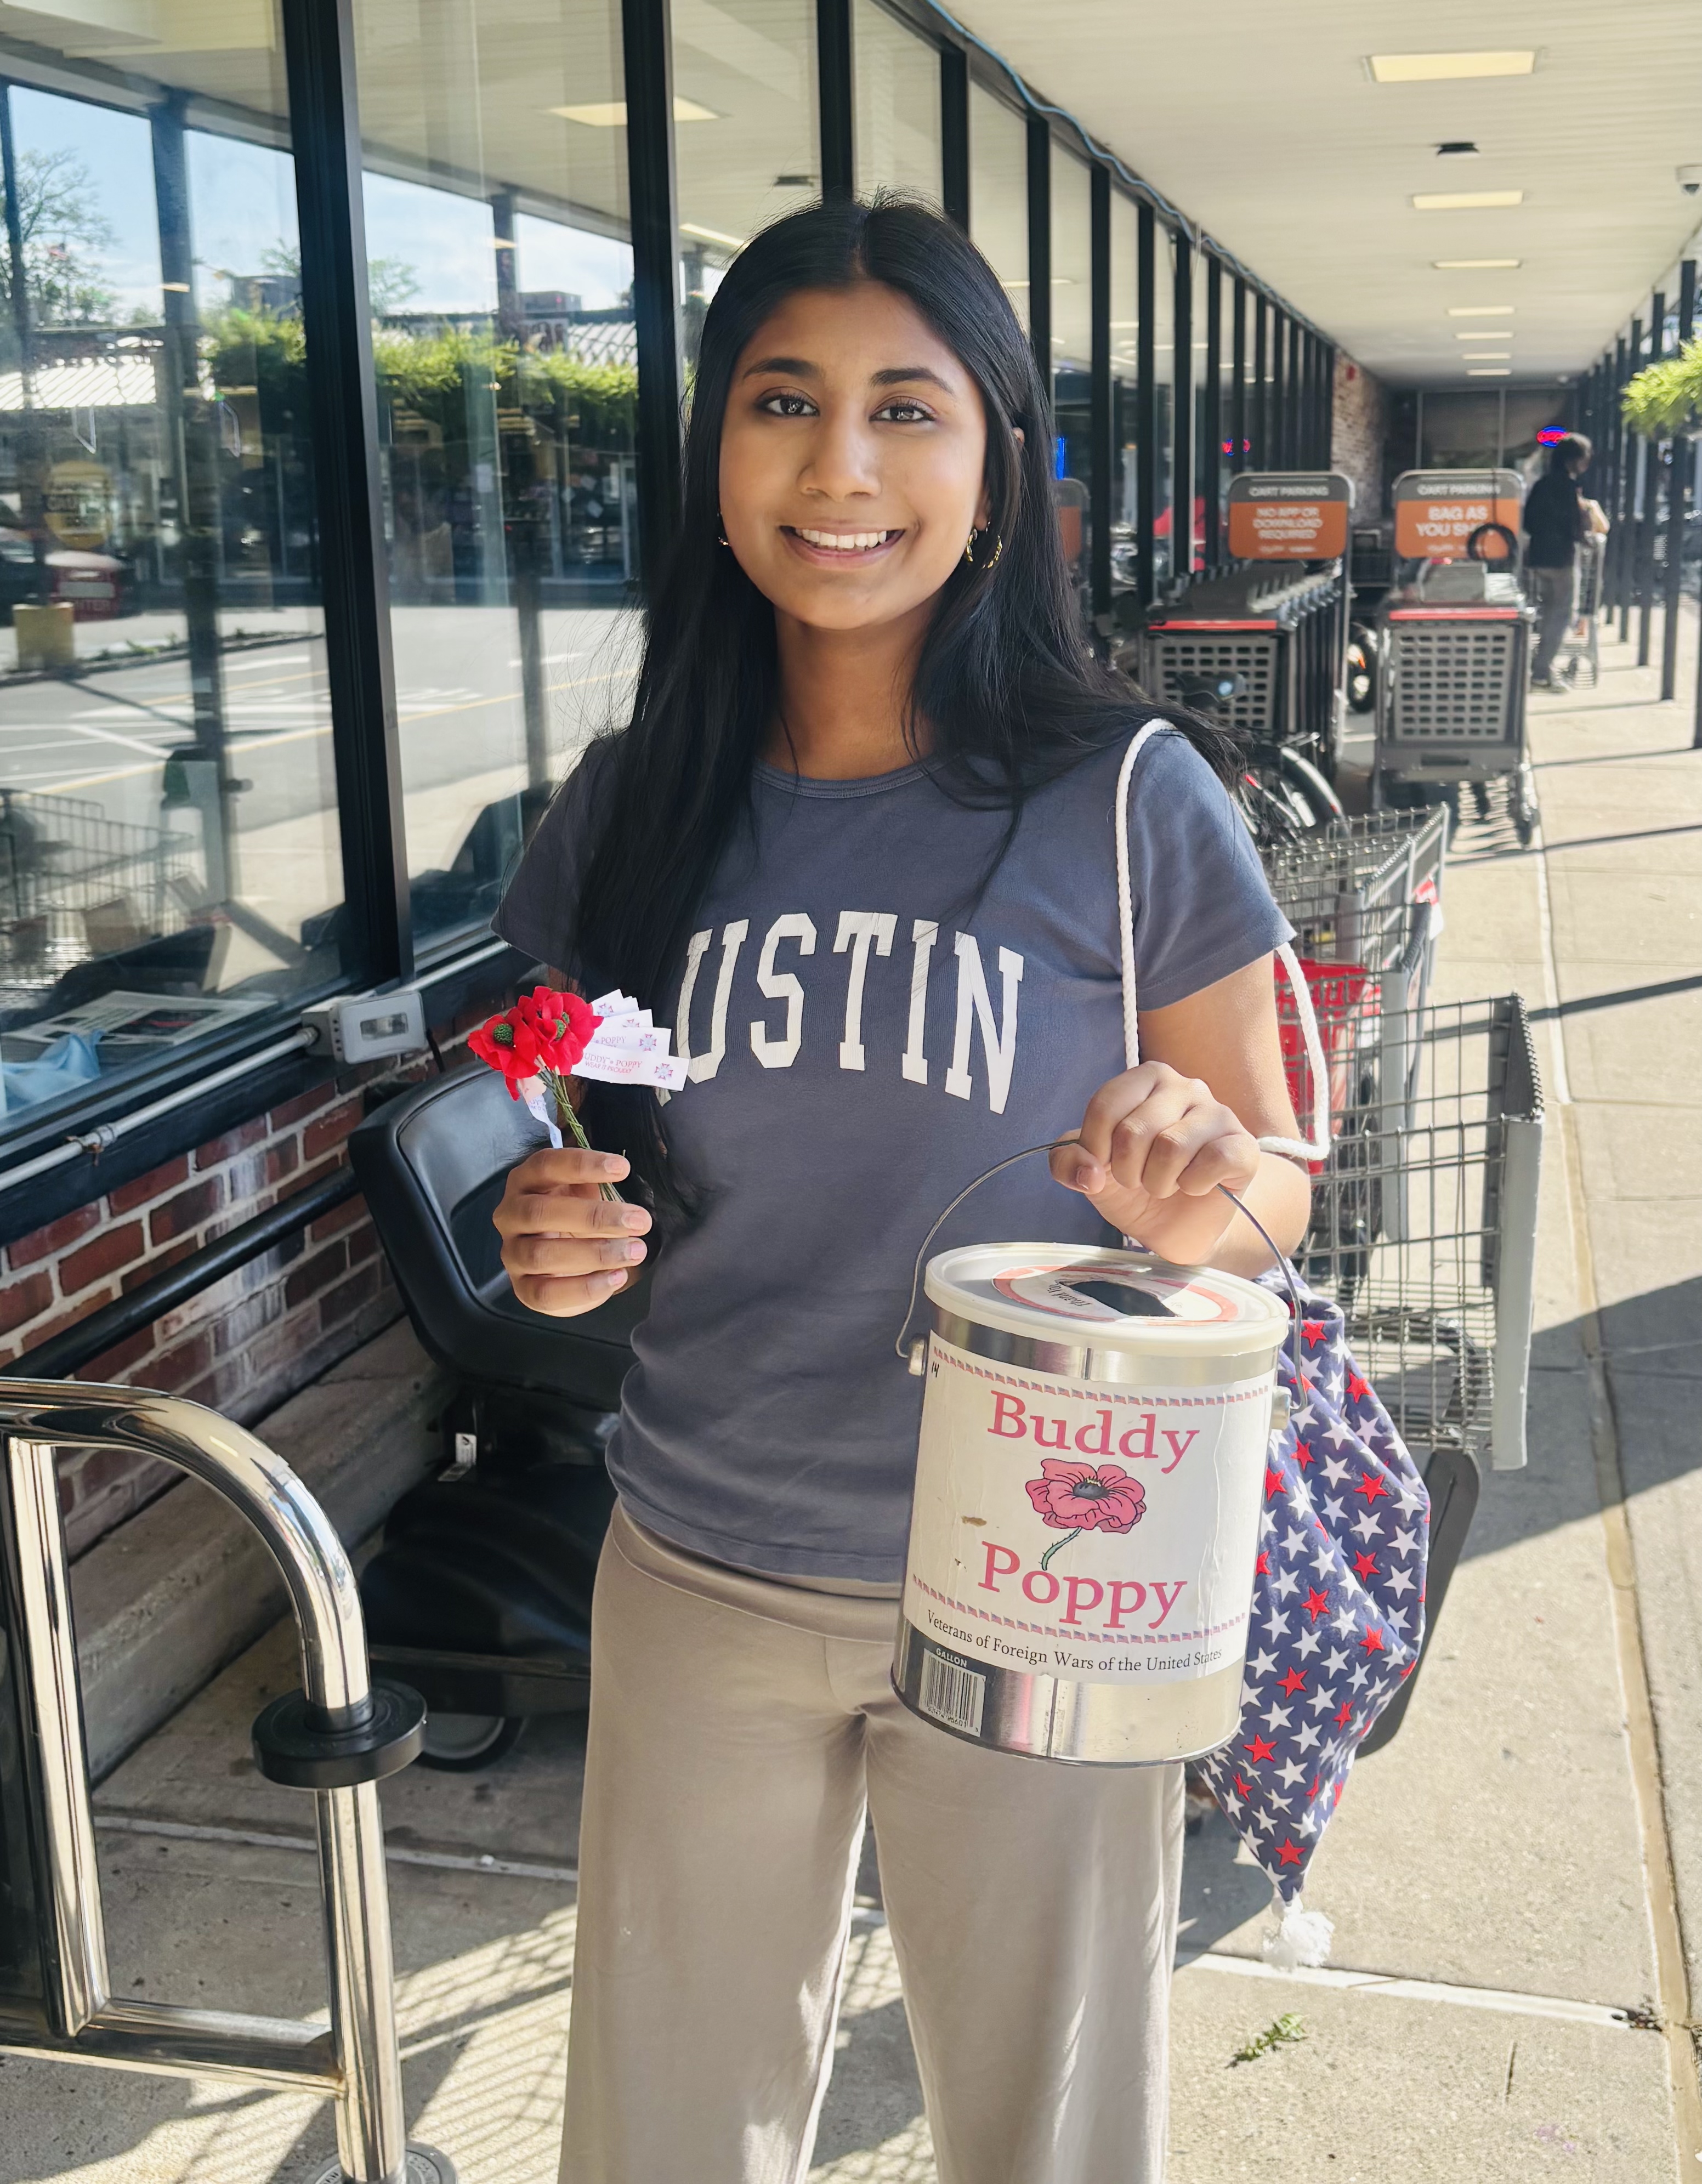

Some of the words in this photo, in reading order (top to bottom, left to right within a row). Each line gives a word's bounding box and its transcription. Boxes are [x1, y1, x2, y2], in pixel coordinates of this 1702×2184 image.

[1416, 523, 1451, 536] YOU
[1428, 507, 1463, 520] BAG
[1466, 506, 1488, 520] AS
[655, 911, 1024, 1114] USTIN
[584, 1053, 609, 1064] UDDY
[616, 1059, 643, 1068] POPPY
[987, 1390, 1200, 1474] Buddy
[977, 1540, 1188, 1630] Poppy
[928, 1609, 972, 1643] Veterans
[976, 1635, 991, 1649] of
[993, 1637, 1048, 1665] Foreign
[1054, 1652, 1093, 1670] Wars
[1098, 1657, 1116, 1671] of
[1118, 1657, 1142, 1671] the
[1147, 1653, 1190, 1671] United
[1194, 1649, 1222, 1665] States
[935, 1648, 968, 1667] GALLON
